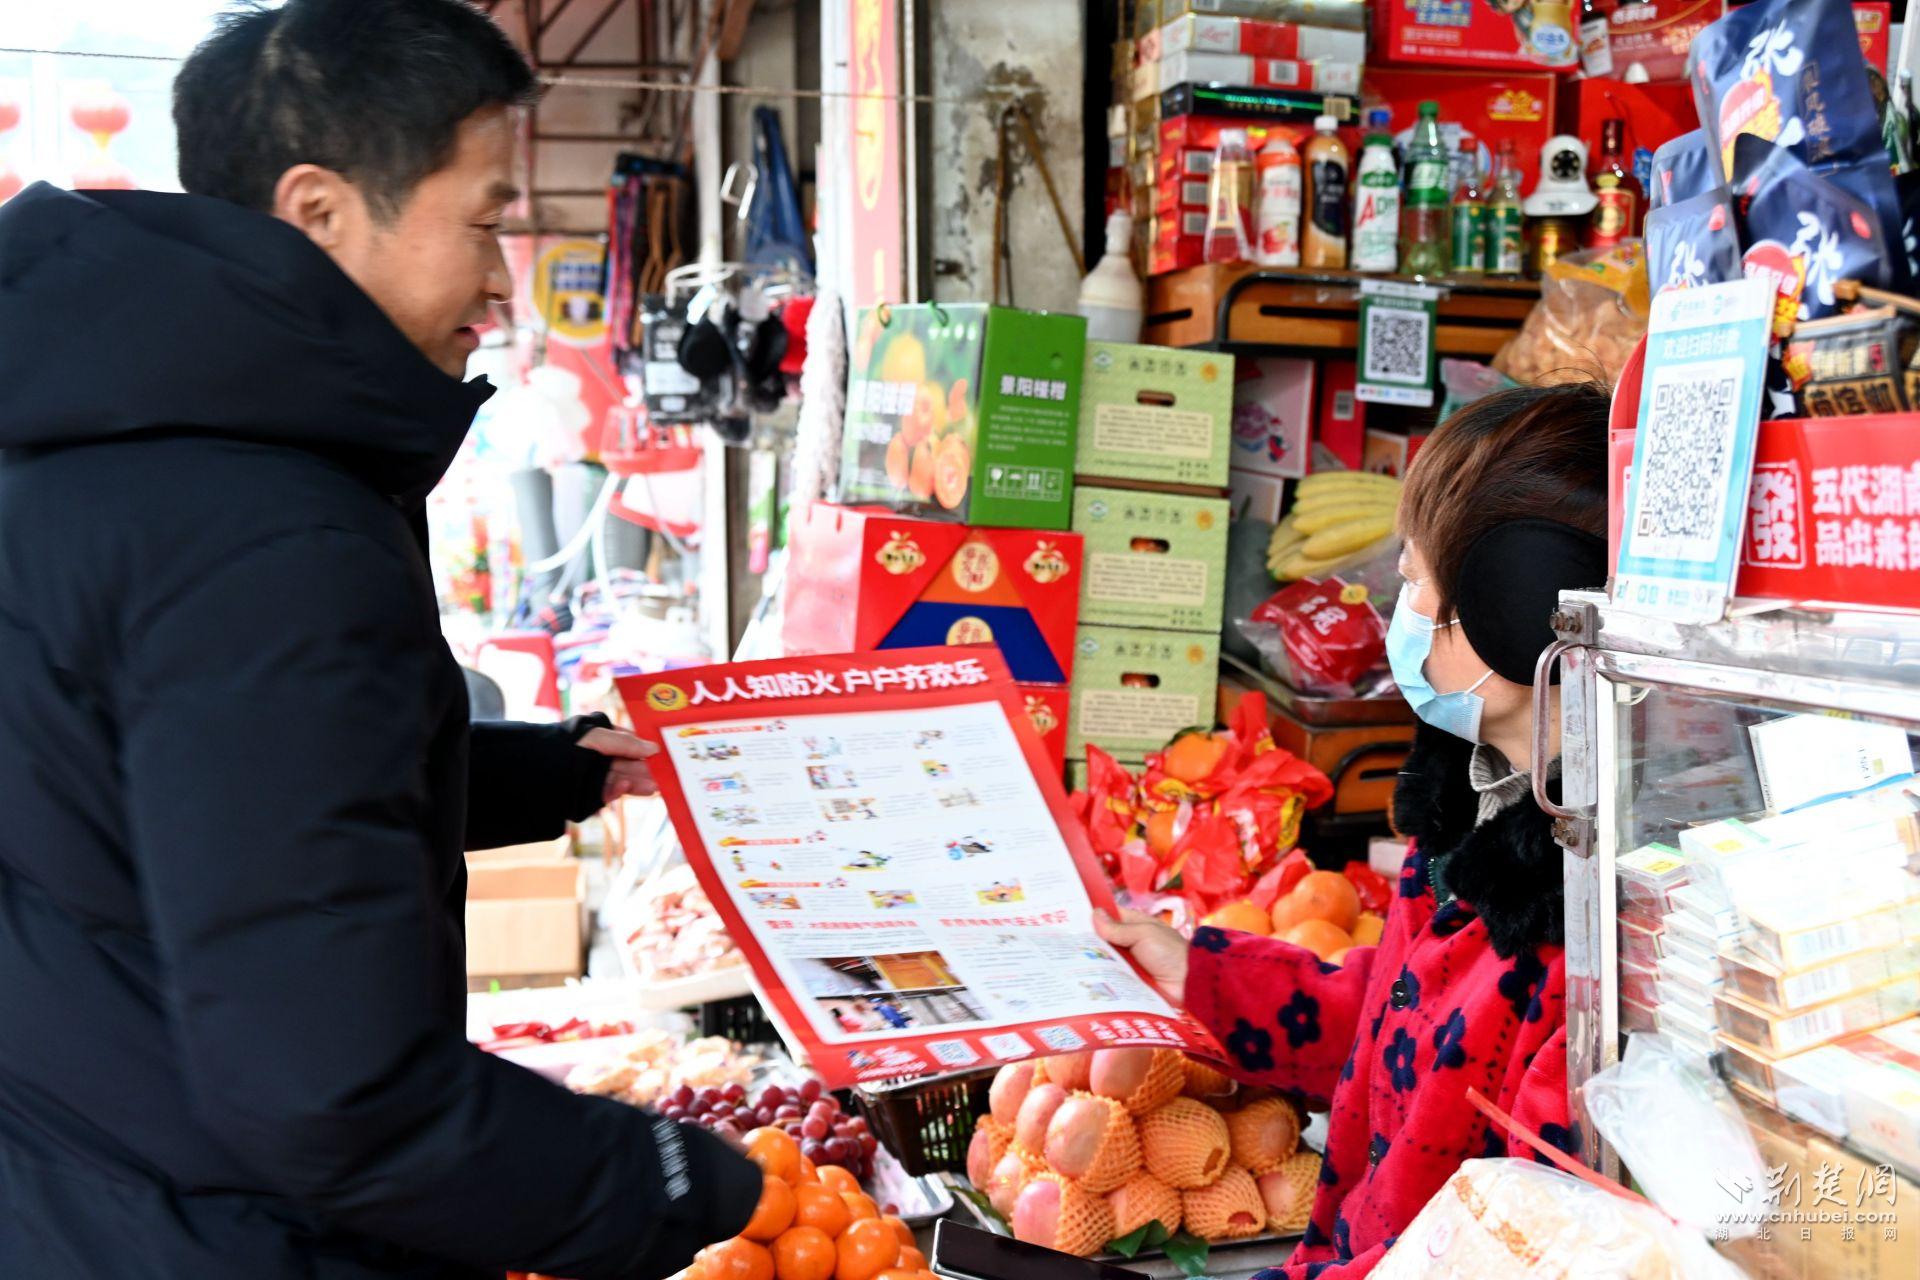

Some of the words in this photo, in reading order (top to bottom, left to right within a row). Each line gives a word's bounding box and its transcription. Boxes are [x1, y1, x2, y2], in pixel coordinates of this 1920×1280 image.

[690, 669, 841, 704] 人人知防火
[842, 659, 988, 692] 户户齐欢乐
